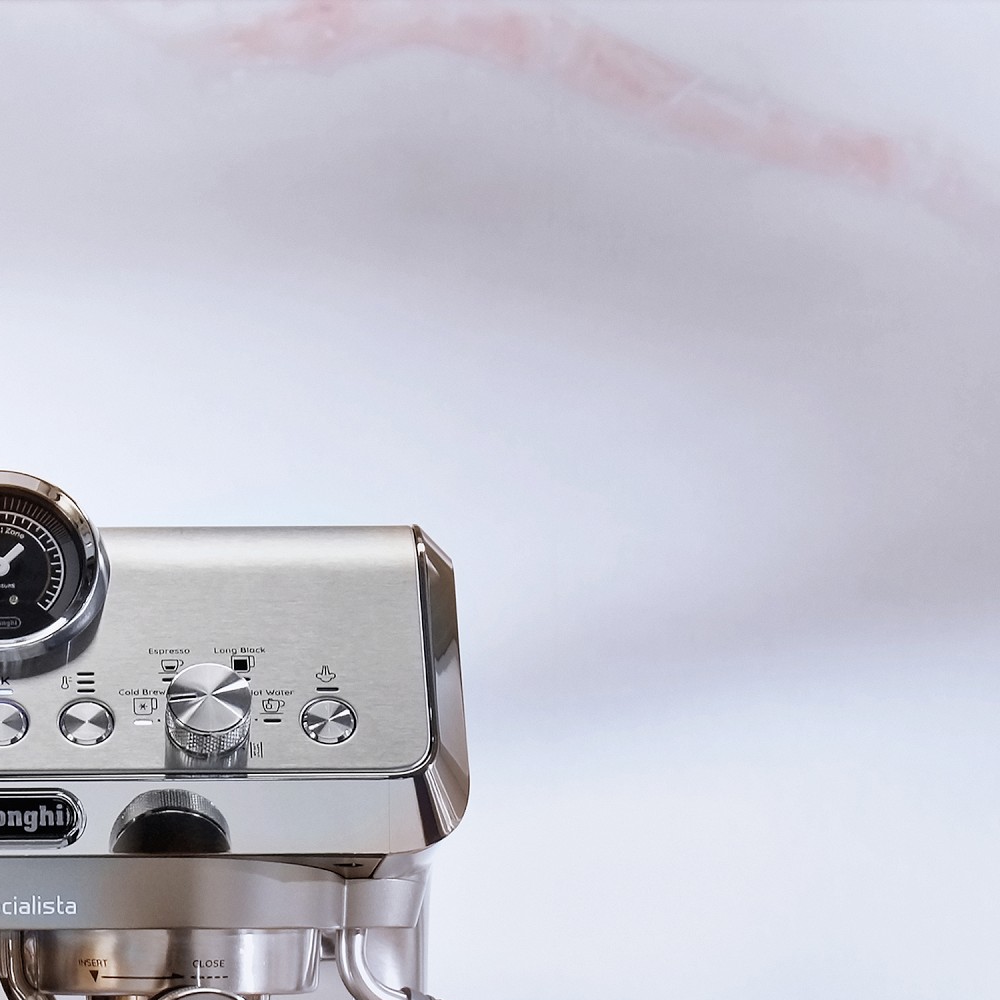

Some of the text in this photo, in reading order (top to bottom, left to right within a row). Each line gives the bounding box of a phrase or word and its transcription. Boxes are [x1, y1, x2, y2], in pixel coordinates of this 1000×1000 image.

[4, 527, 25, 540] Zone
[148, 648, 190, 656] Espresso
[213, 647, 238, 656] Long
[118, 688, 166, 696] Cold Brew
[78, 959, 225, 968] INSERT CLOSE
